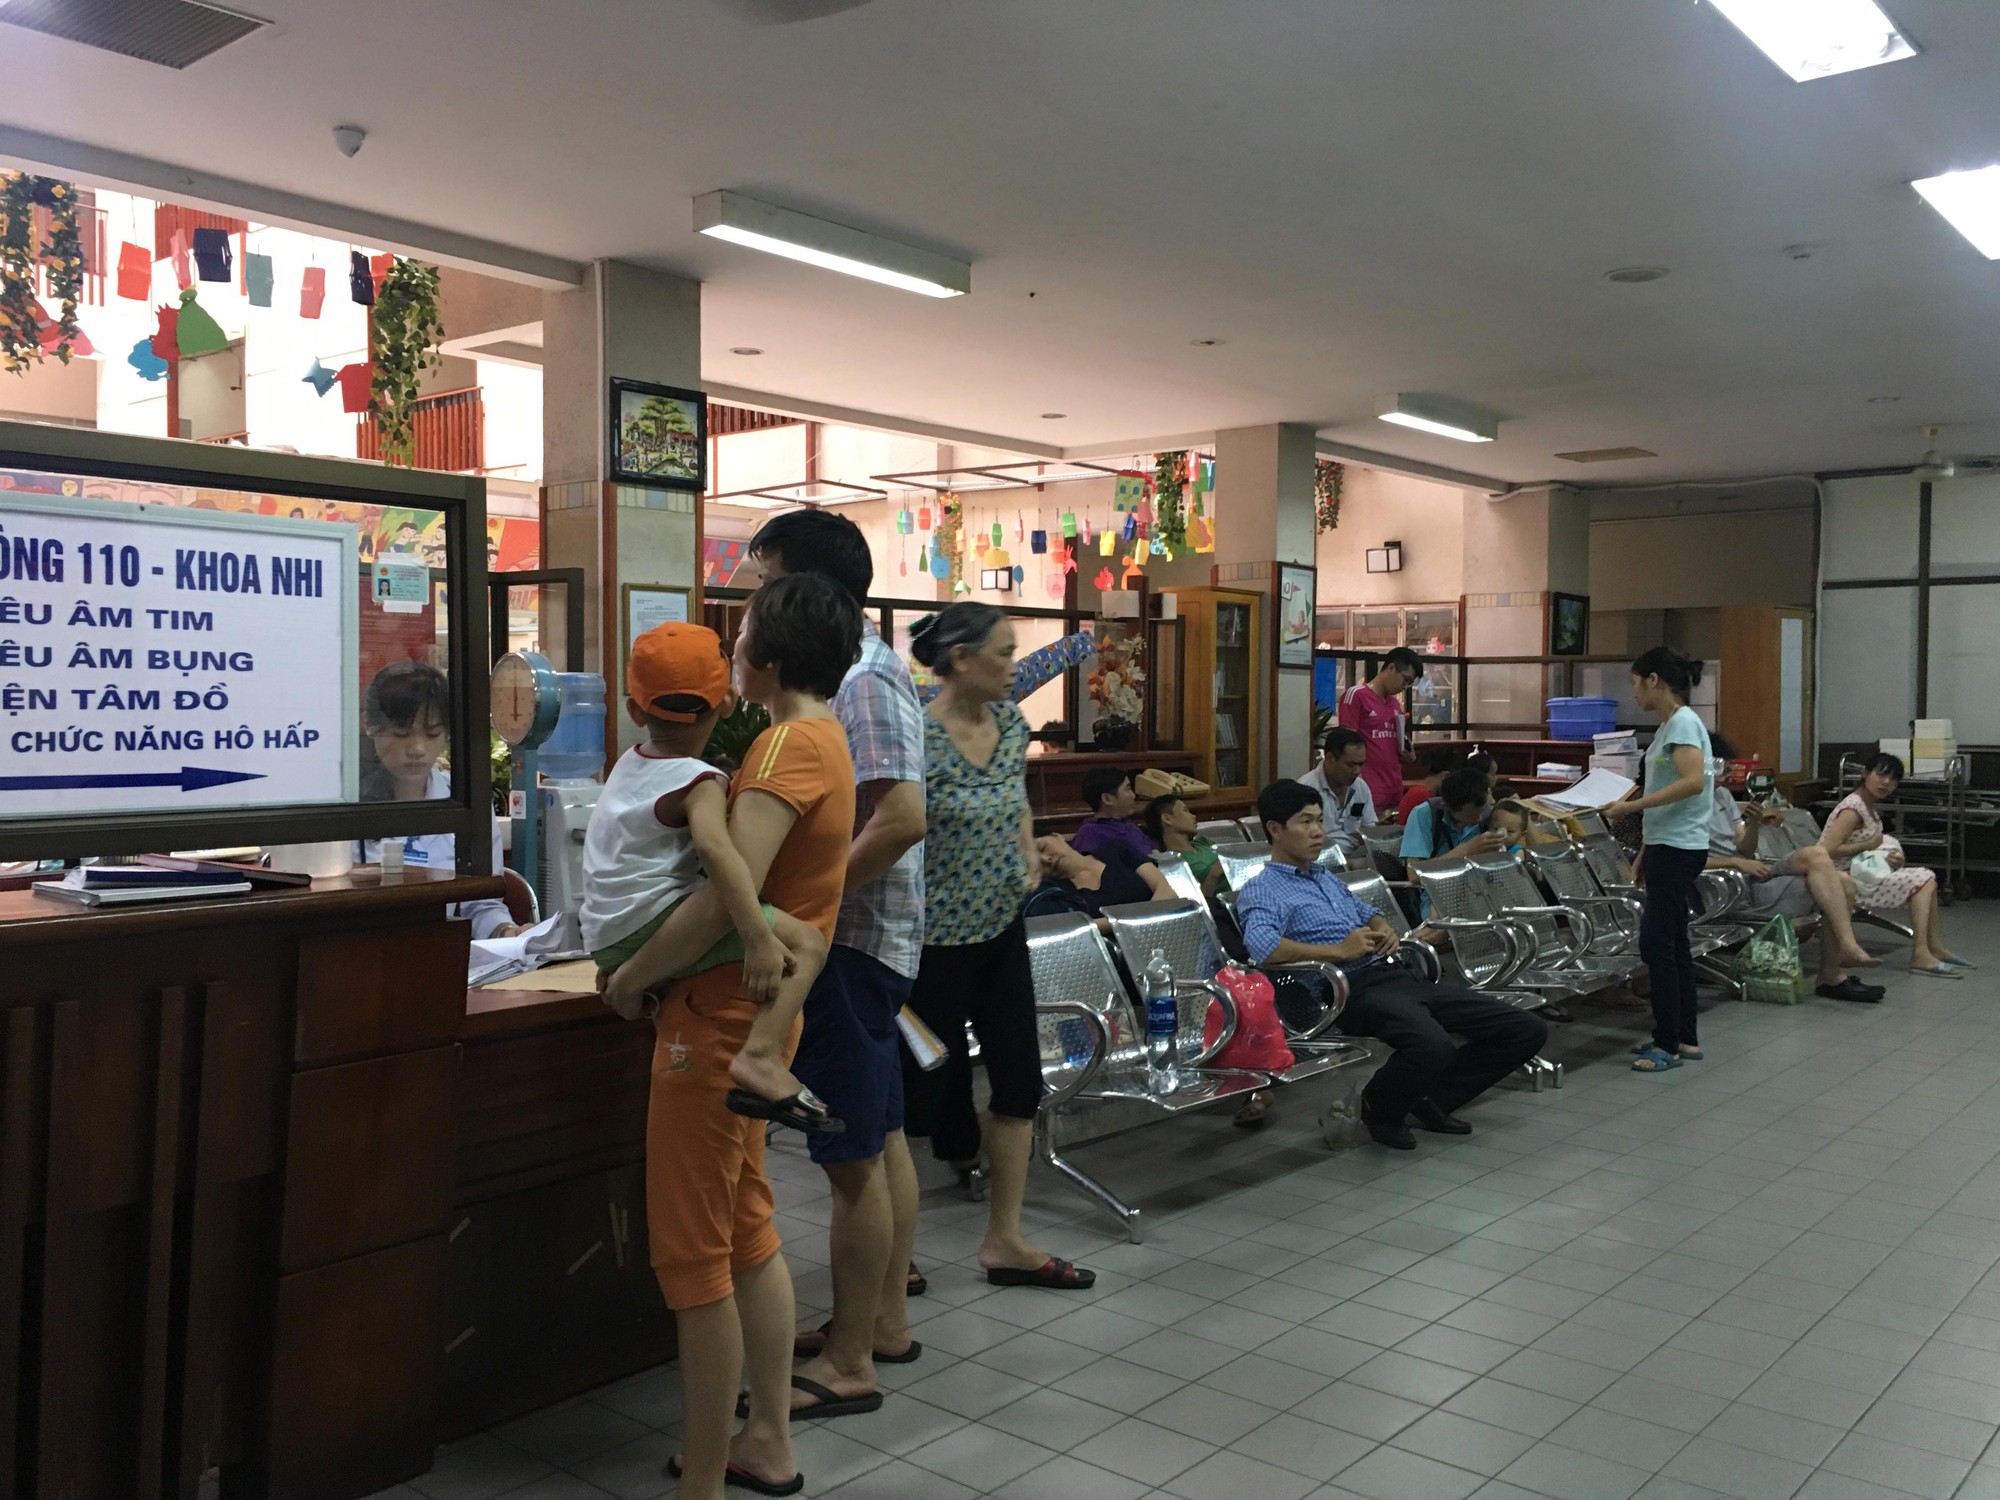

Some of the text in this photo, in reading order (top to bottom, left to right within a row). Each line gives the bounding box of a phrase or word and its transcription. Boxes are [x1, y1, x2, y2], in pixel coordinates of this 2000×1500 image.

[78, 543, 139, 587] 110
[152, 567, 163, 575] -
[176, 550, 261, 594] KHOA
[272, 557, 322, 597] NHI
[68, 600, 132, 628] ÂM
[146, 609, 212, 631] TIM
[68, 642, 132, 669] ÂM
[148, 650, 253, 676] BỤNG
[3, 683, 228, 716] ỆN TÂM ĐỒ
[11, 721, 319, 753] CHỨC NĂNG HÔ HẤP
